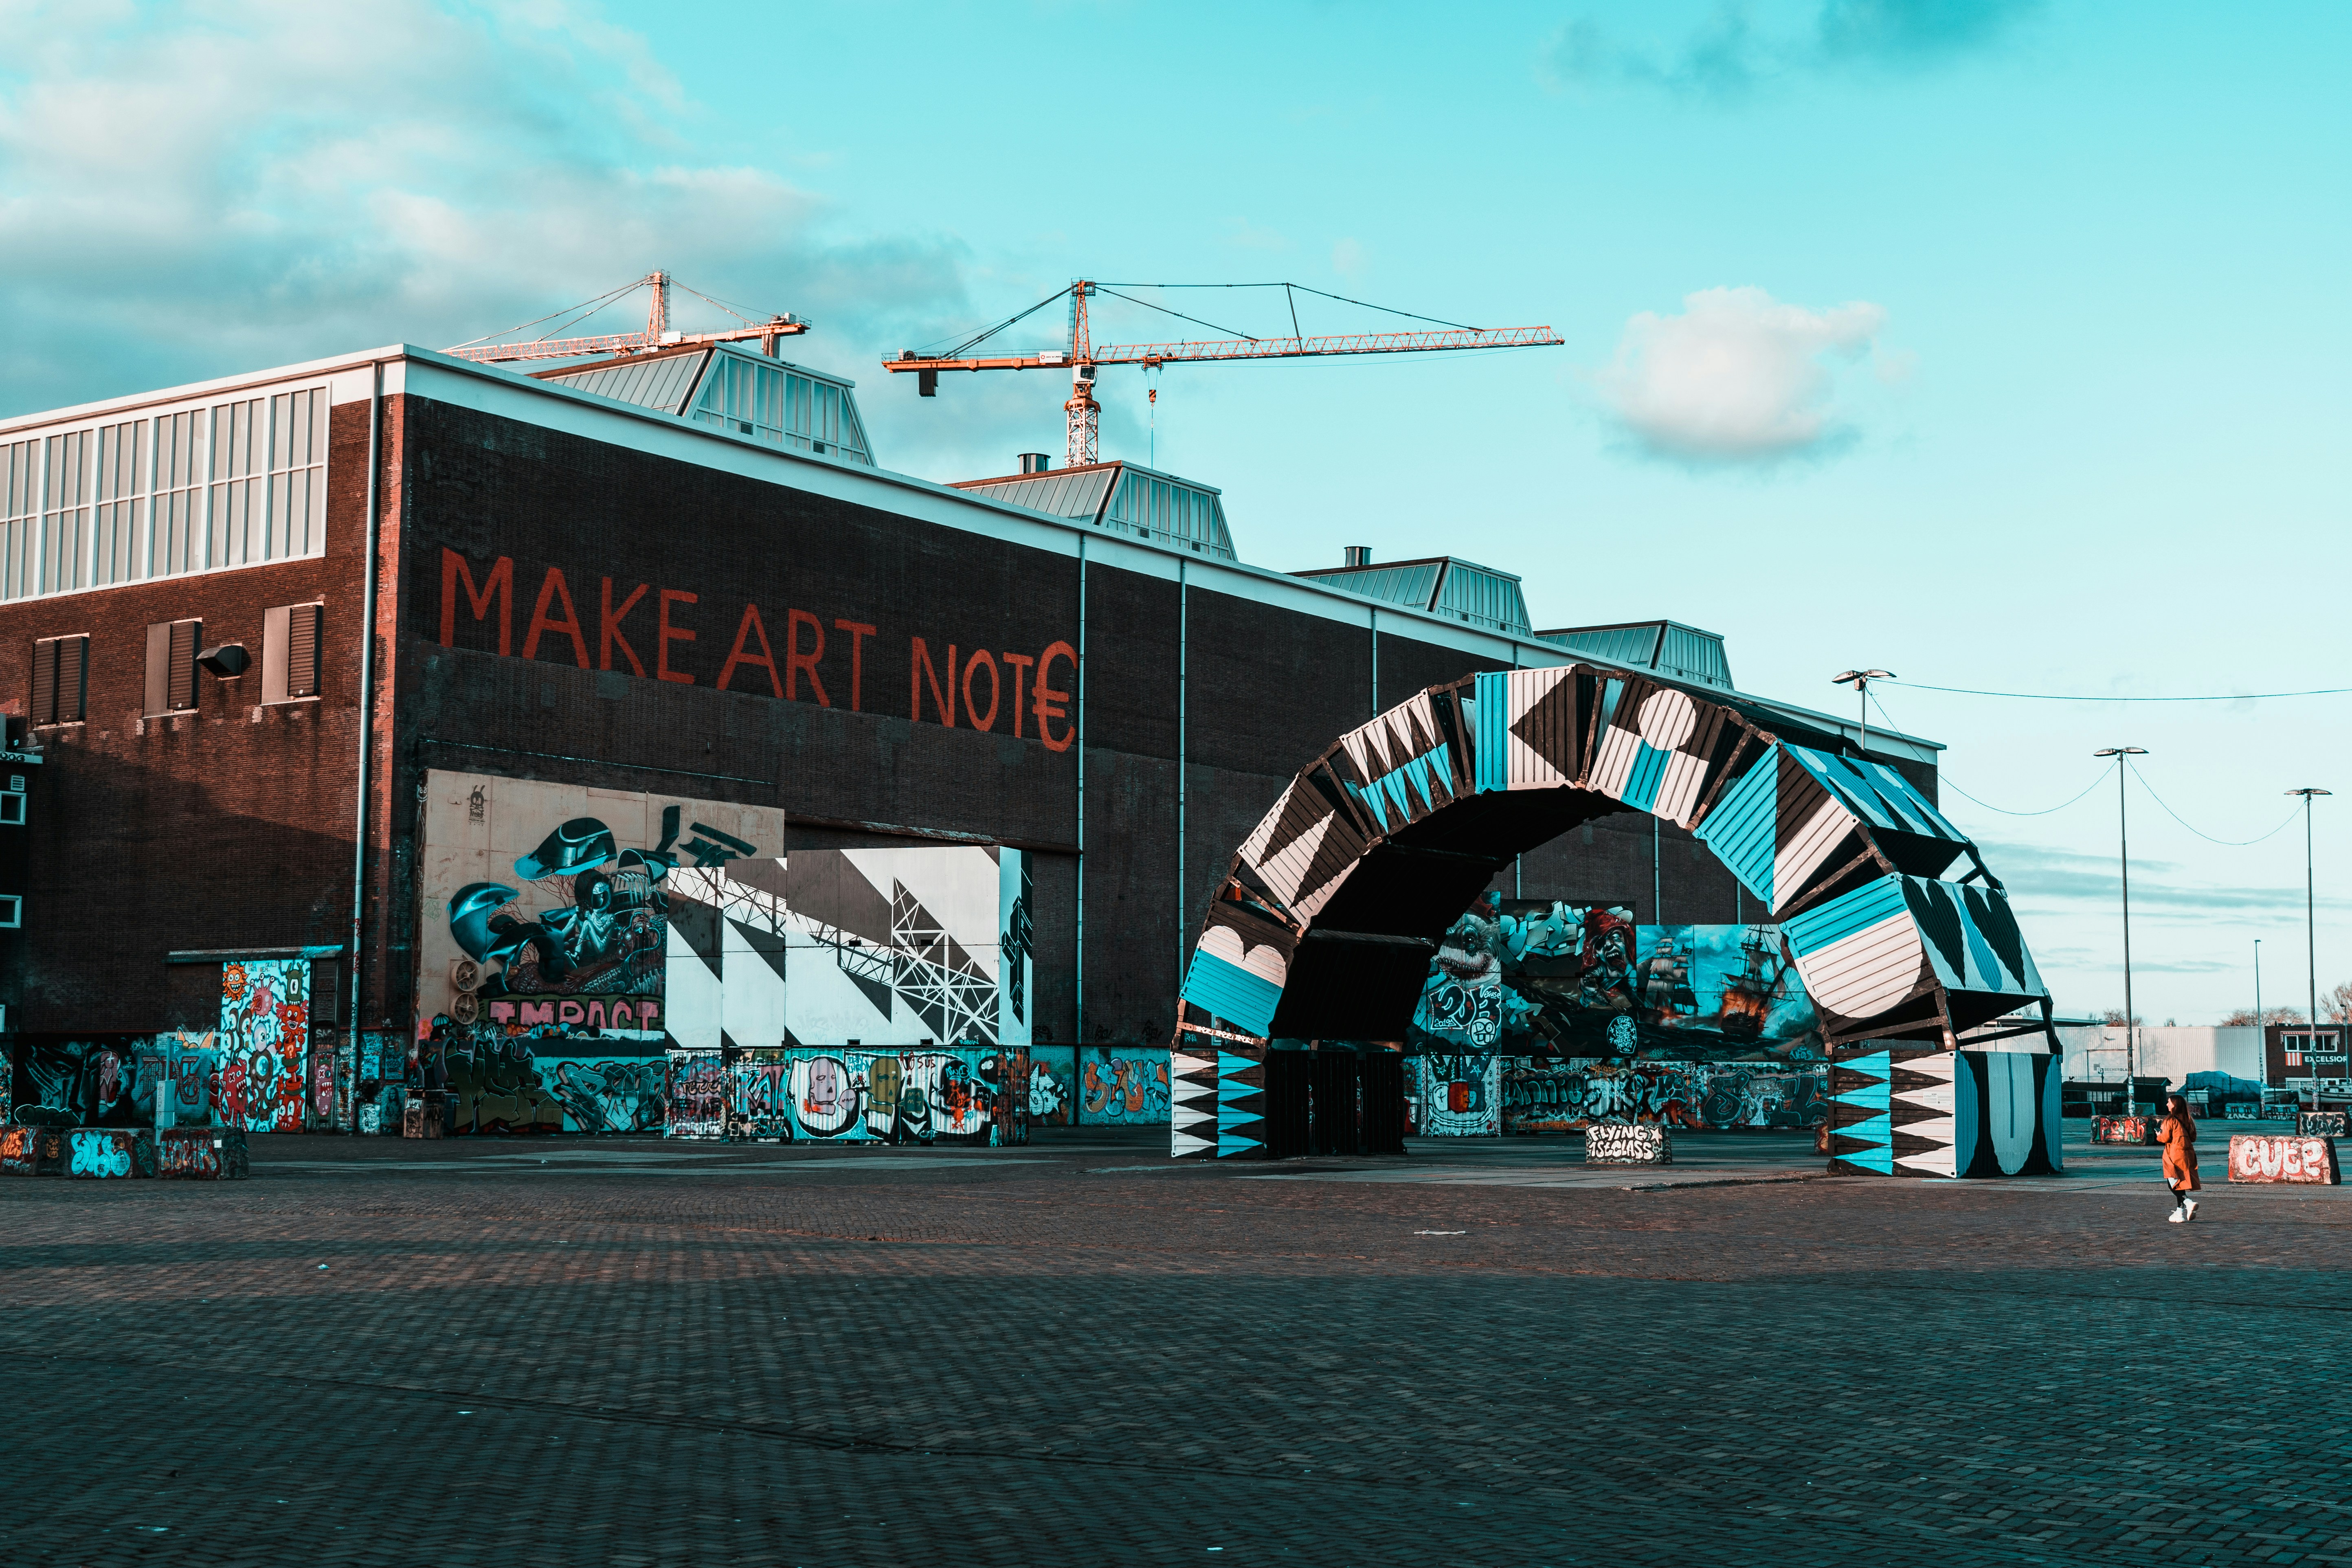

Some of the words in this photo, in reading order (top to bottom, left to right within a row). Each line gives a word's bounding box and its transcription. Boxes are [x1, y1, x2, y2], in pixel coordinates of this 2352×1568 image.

[440, 547, 698, 684] MAKE
[716, 604, 876, 712] ART
[490, 999, 659, 1030] IMPACT
[173, 1046, 179, 1054] P
